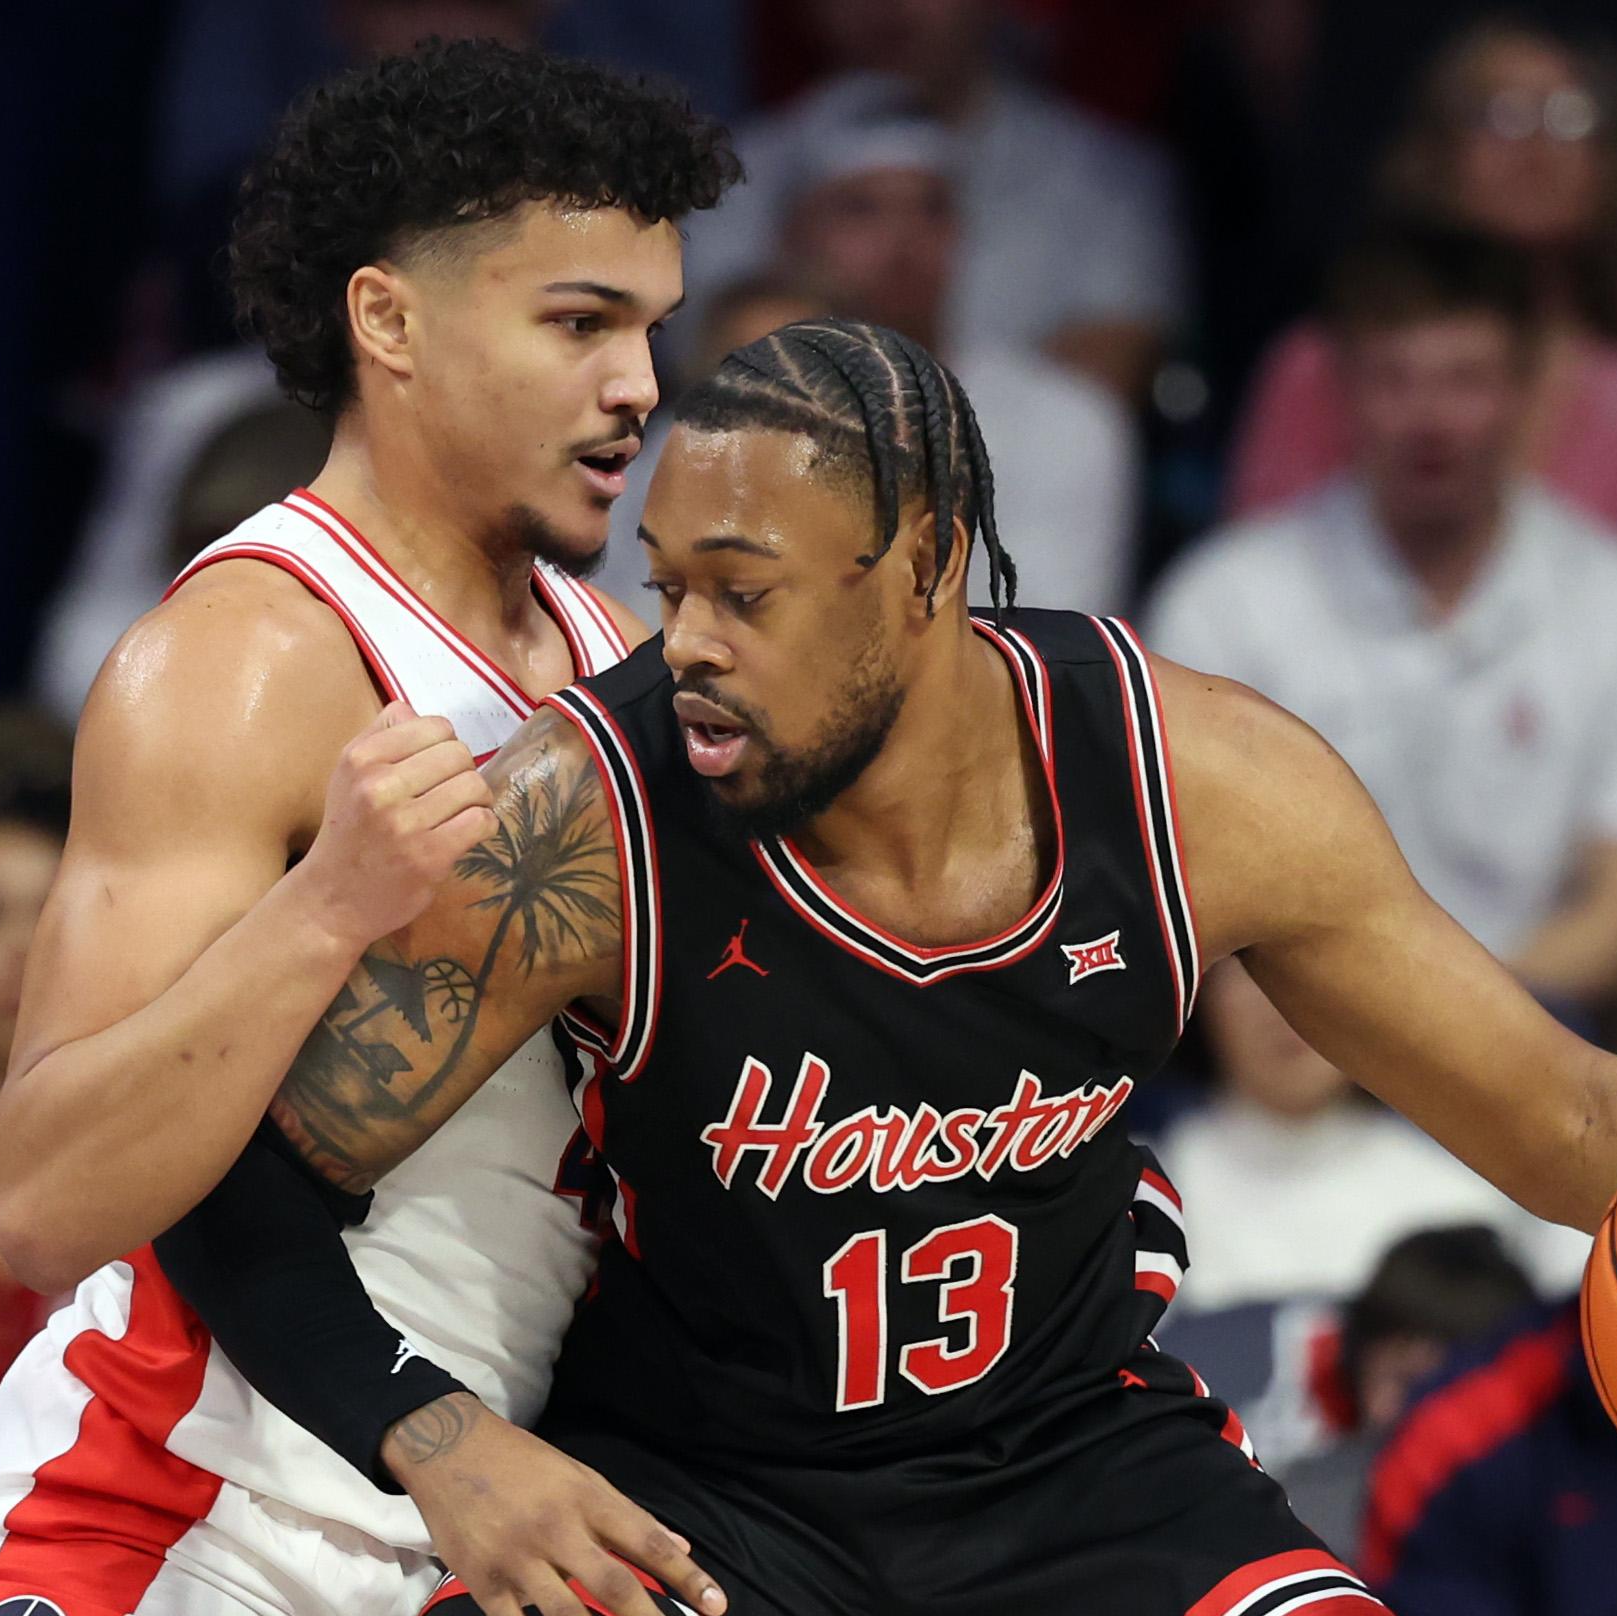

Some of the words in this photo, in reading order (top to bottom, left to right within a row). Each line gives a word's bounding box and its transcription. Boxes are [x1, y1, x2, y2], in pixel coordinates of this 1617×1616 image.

[1068, 938, 1121, 977] XII
[699, 1050, 1134, 1202] Houston
[822, 1212, 1019, 1413] 13
